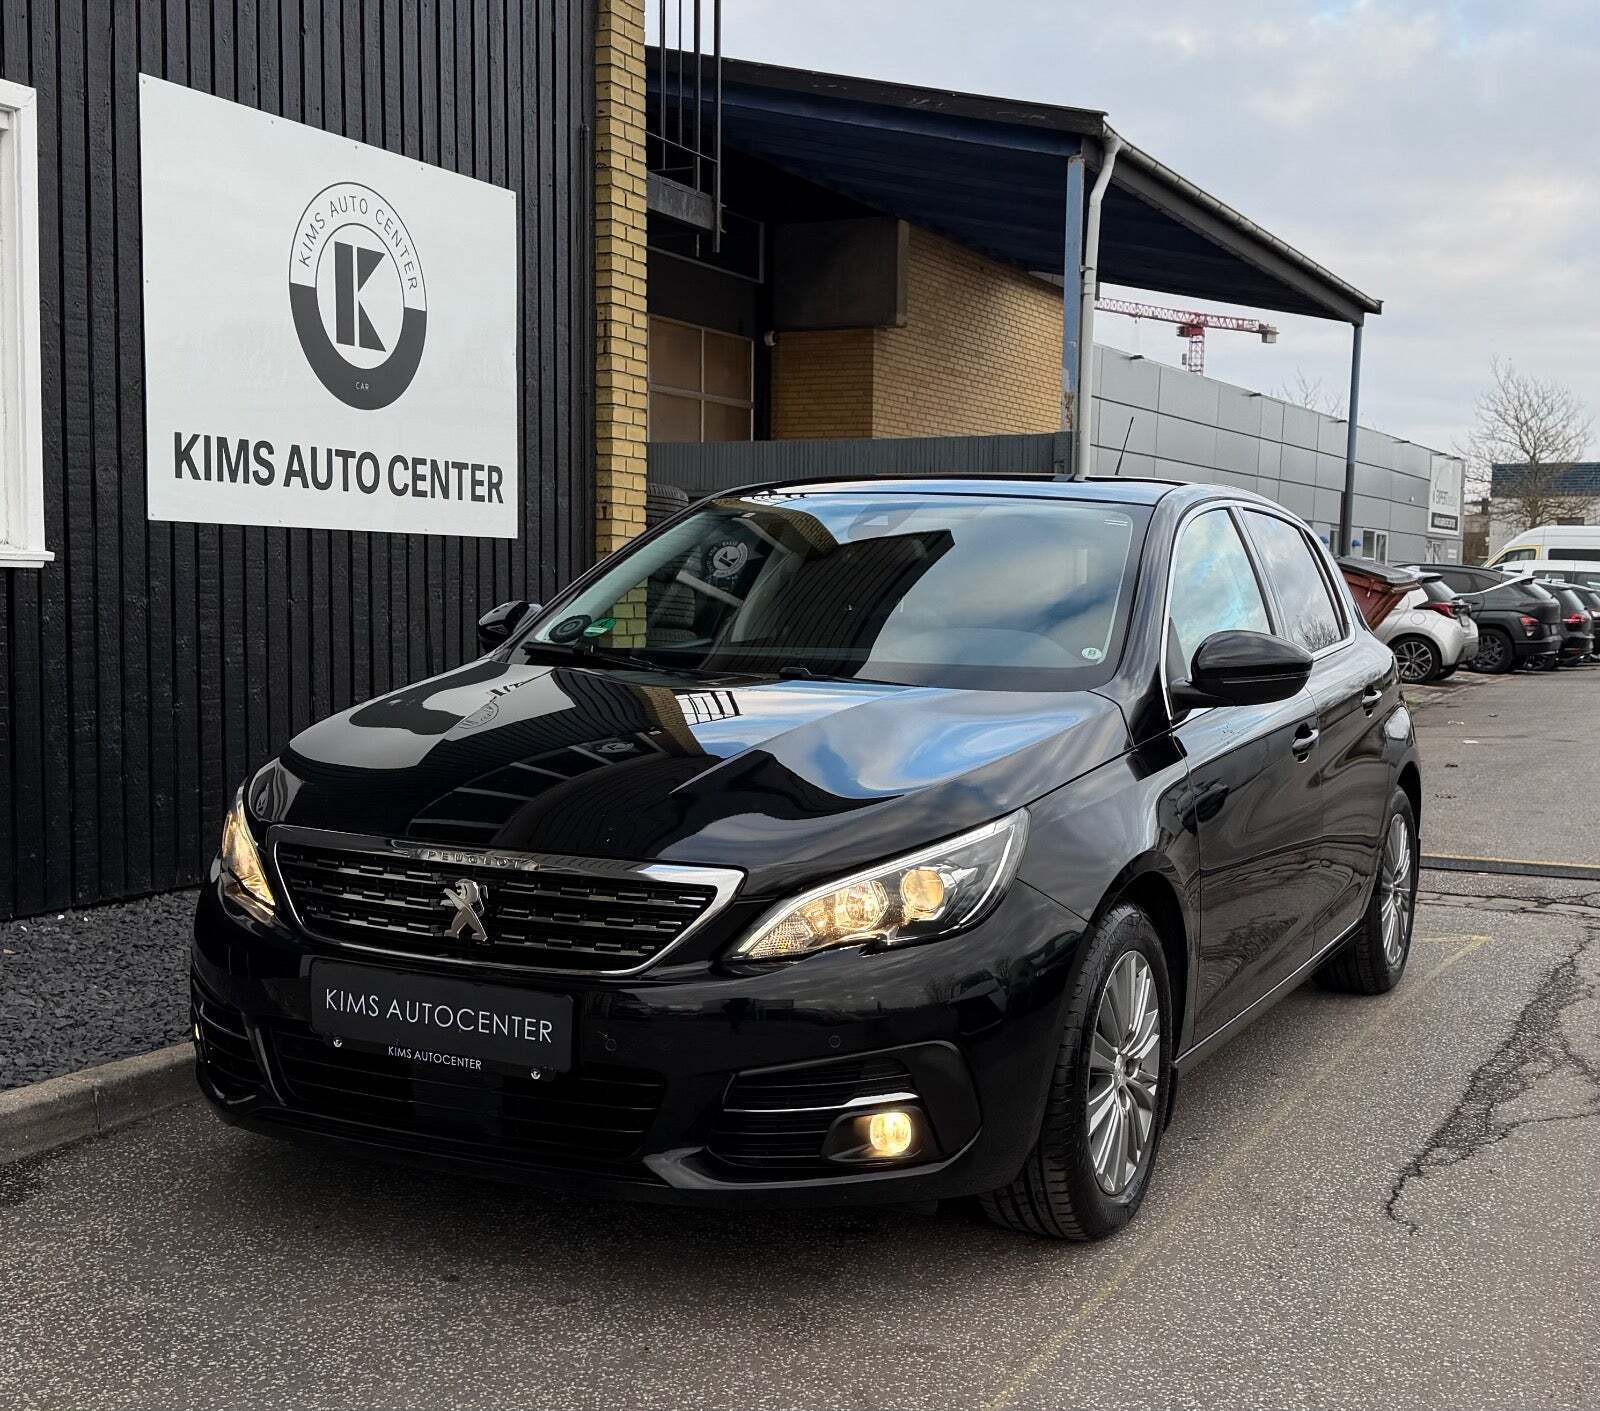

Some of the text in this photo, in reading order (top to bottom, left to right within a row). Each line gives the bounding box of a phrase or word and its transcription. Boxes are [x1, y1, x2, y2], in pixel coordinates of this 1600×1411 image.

[299, 195, 418, 290] KIMS AUTO CENTER
[334, 241, 387, 352] K
[355, 381, 370, 390] CAR
[173, 431, 504, 504] KIMS AUTO CENTER
[426, 850, 521, 870] PEUGEOT
[326, 988, 553, 1043] KIMS AUTOCENTER
[388, 1046, 482, 1070] KIMS AUTOCENTER
